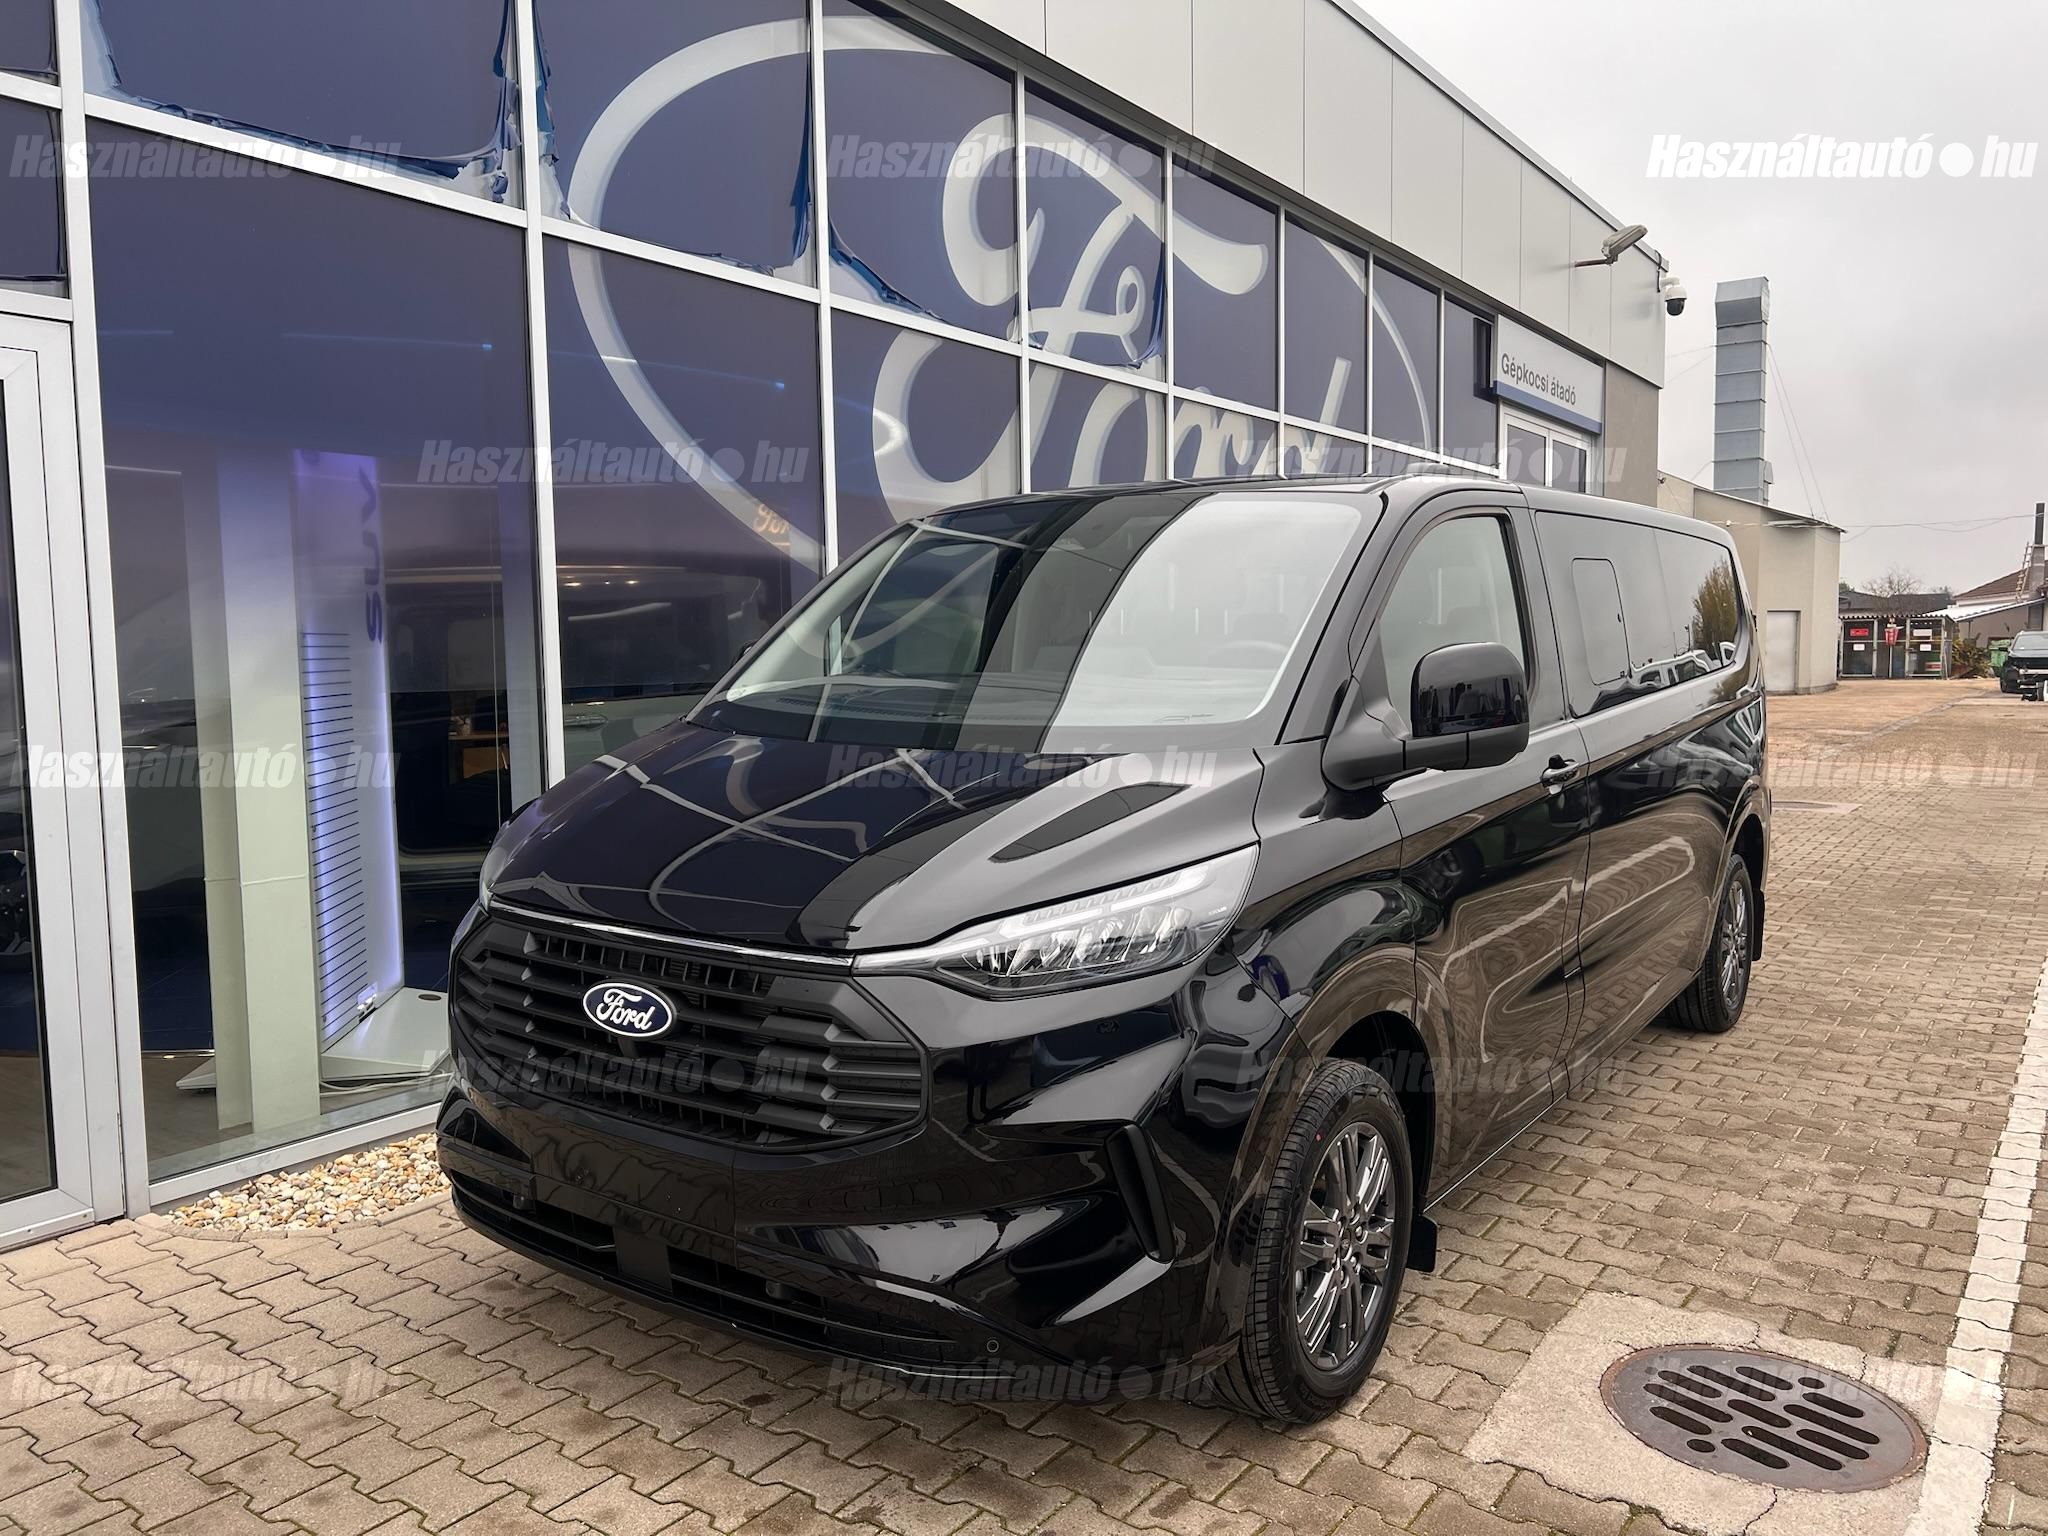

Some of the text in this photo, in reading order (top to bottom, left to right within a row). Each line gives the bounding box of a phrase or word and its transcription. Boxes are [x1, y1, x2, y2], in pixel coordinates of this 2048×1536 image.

[1501, 353, 1576, 405] Gépkocsi átadó
[596, 988, 656, 1030] Ford
